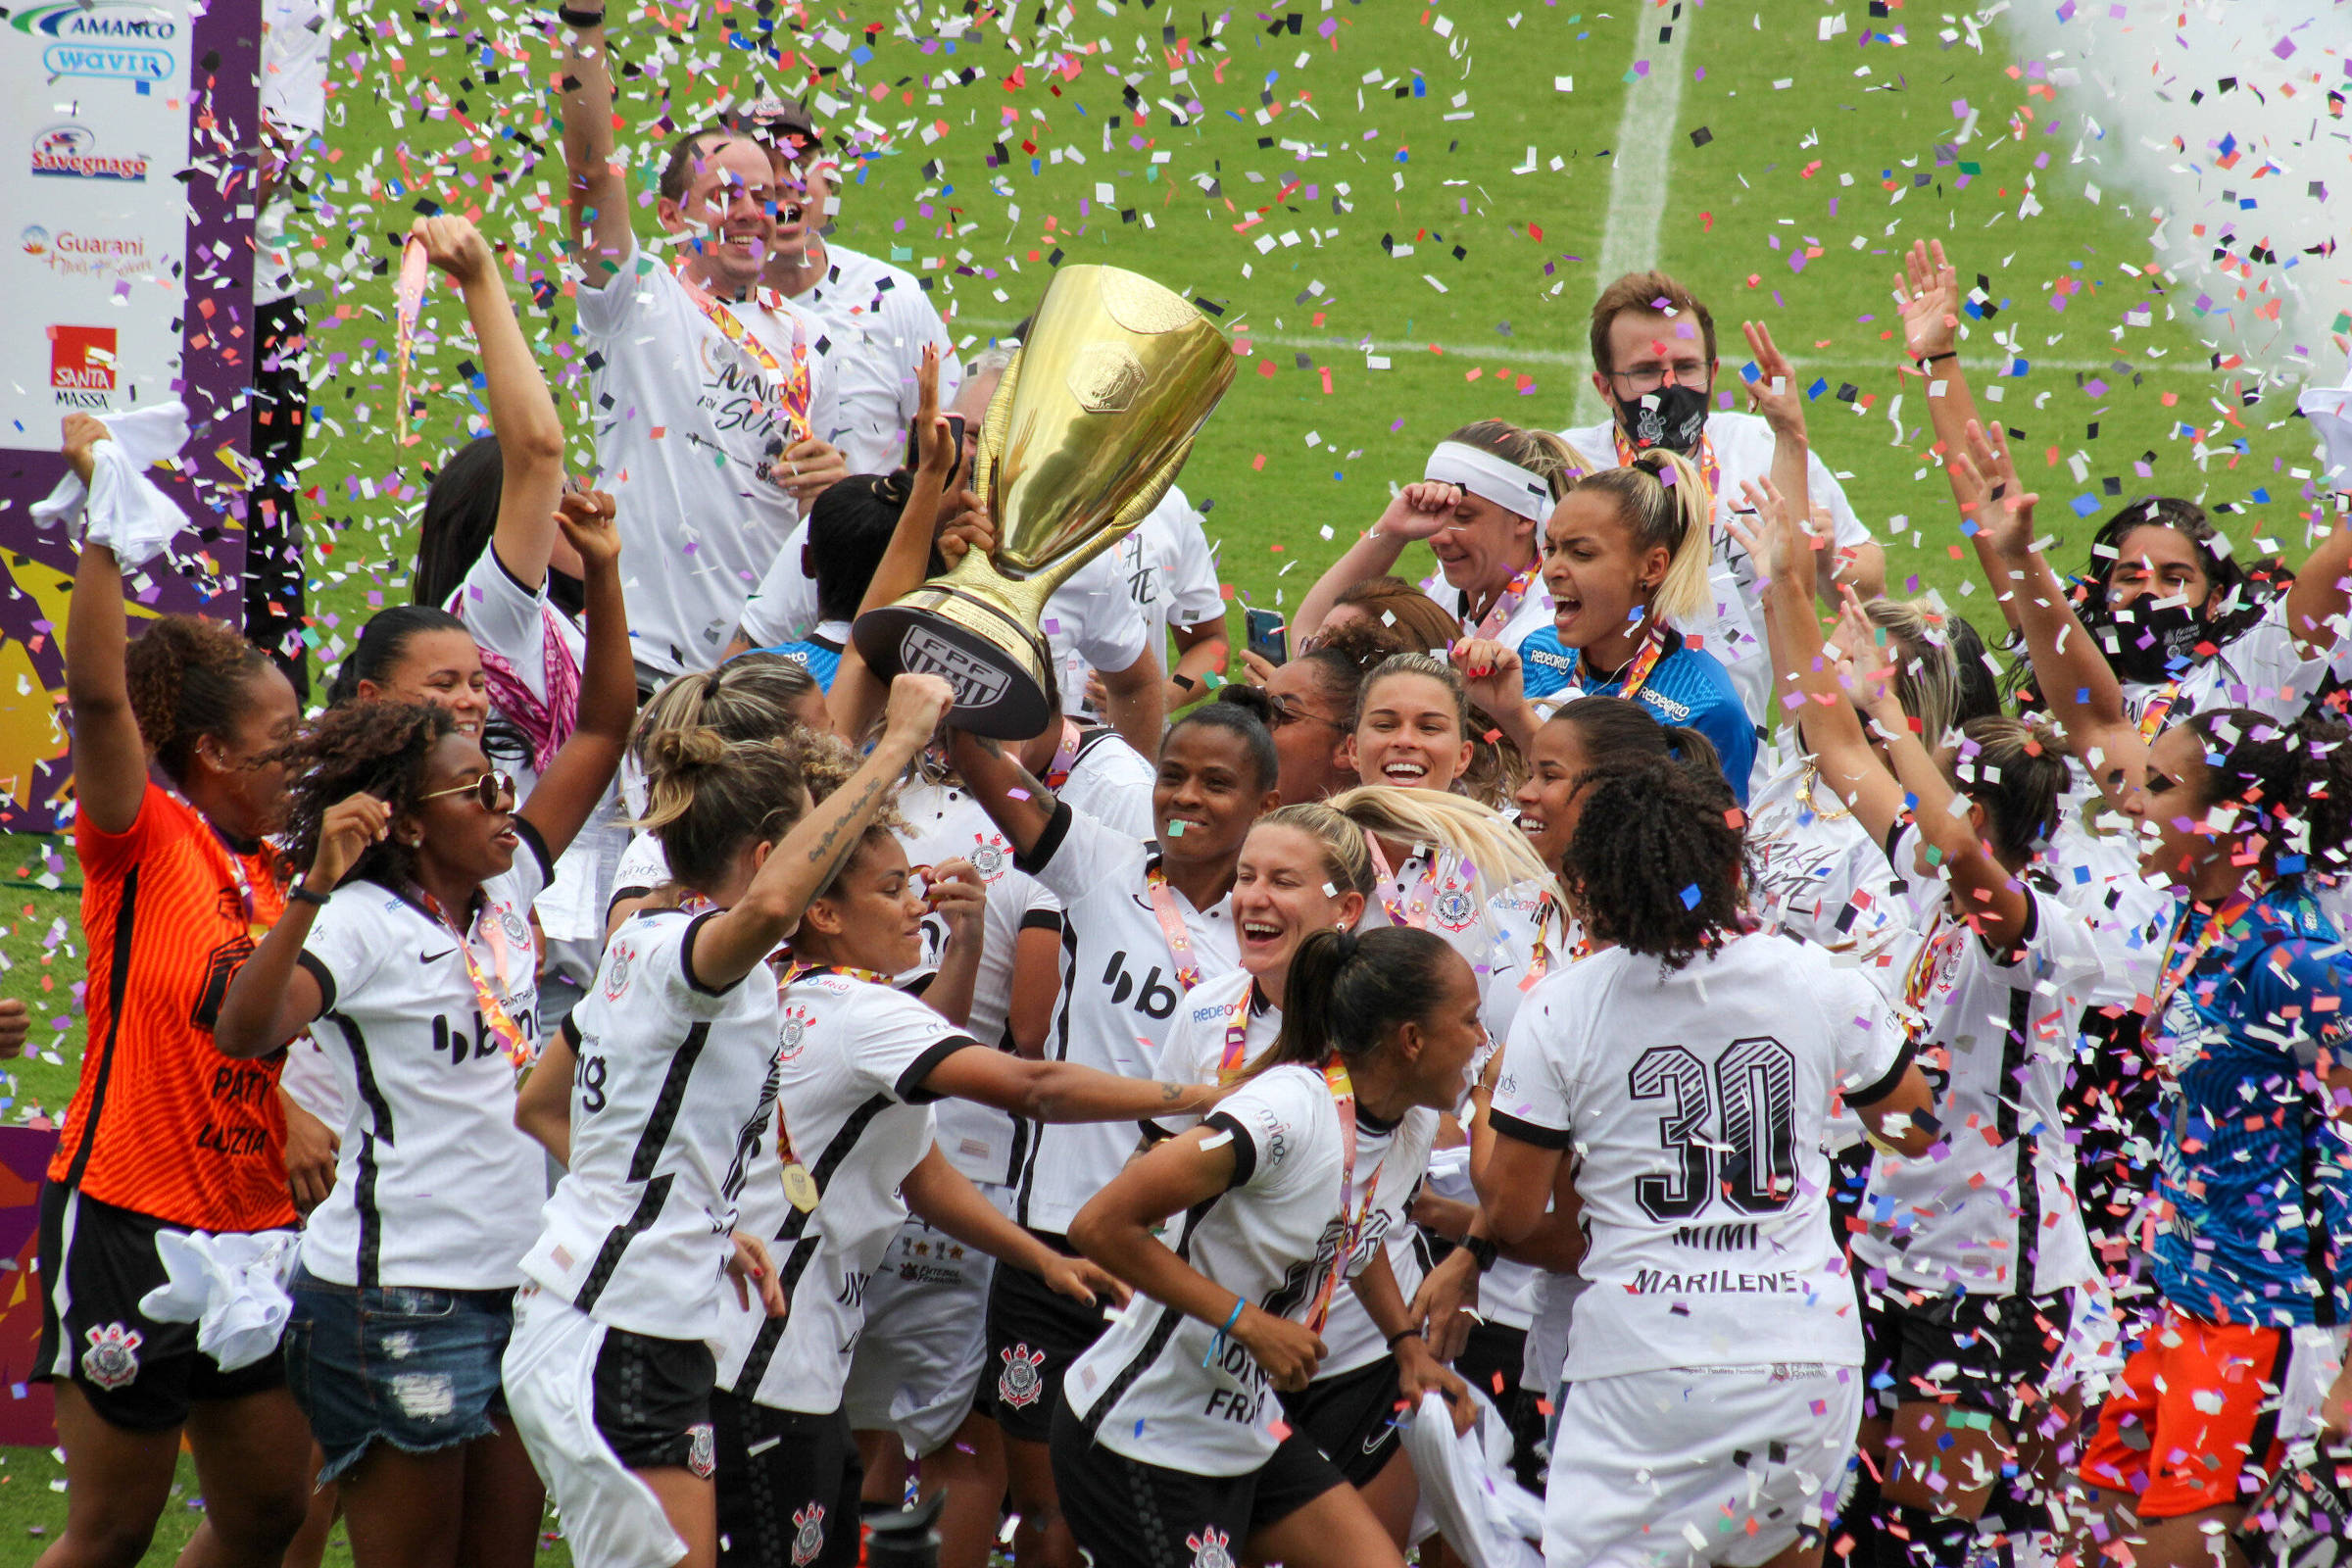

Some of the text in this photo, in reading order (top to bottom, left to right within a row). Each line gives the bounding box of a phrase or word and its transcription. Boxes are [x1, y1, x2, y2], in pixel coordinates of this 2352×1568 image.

[71, 18, 175, 39] AMANCO
[57, 50, 159, 73] wavin
[32, 150, 147, 178] Savegnago
[56, 230, 145, 257] Guarani
[55, 366, 111, 389] SANTA
[55, 390, 111, 411] MASSA
[921, 637, 994, 676] FPF
[213, 1067, 272, 1105] PATY
[197, 1124, 269, 1155] LUZIA
[1628, 1035, 1800, 1224] 30
[1672, 1223, 1758, 1252] MIMI
[1631, 1269, 1797, 1295] MARILENE
